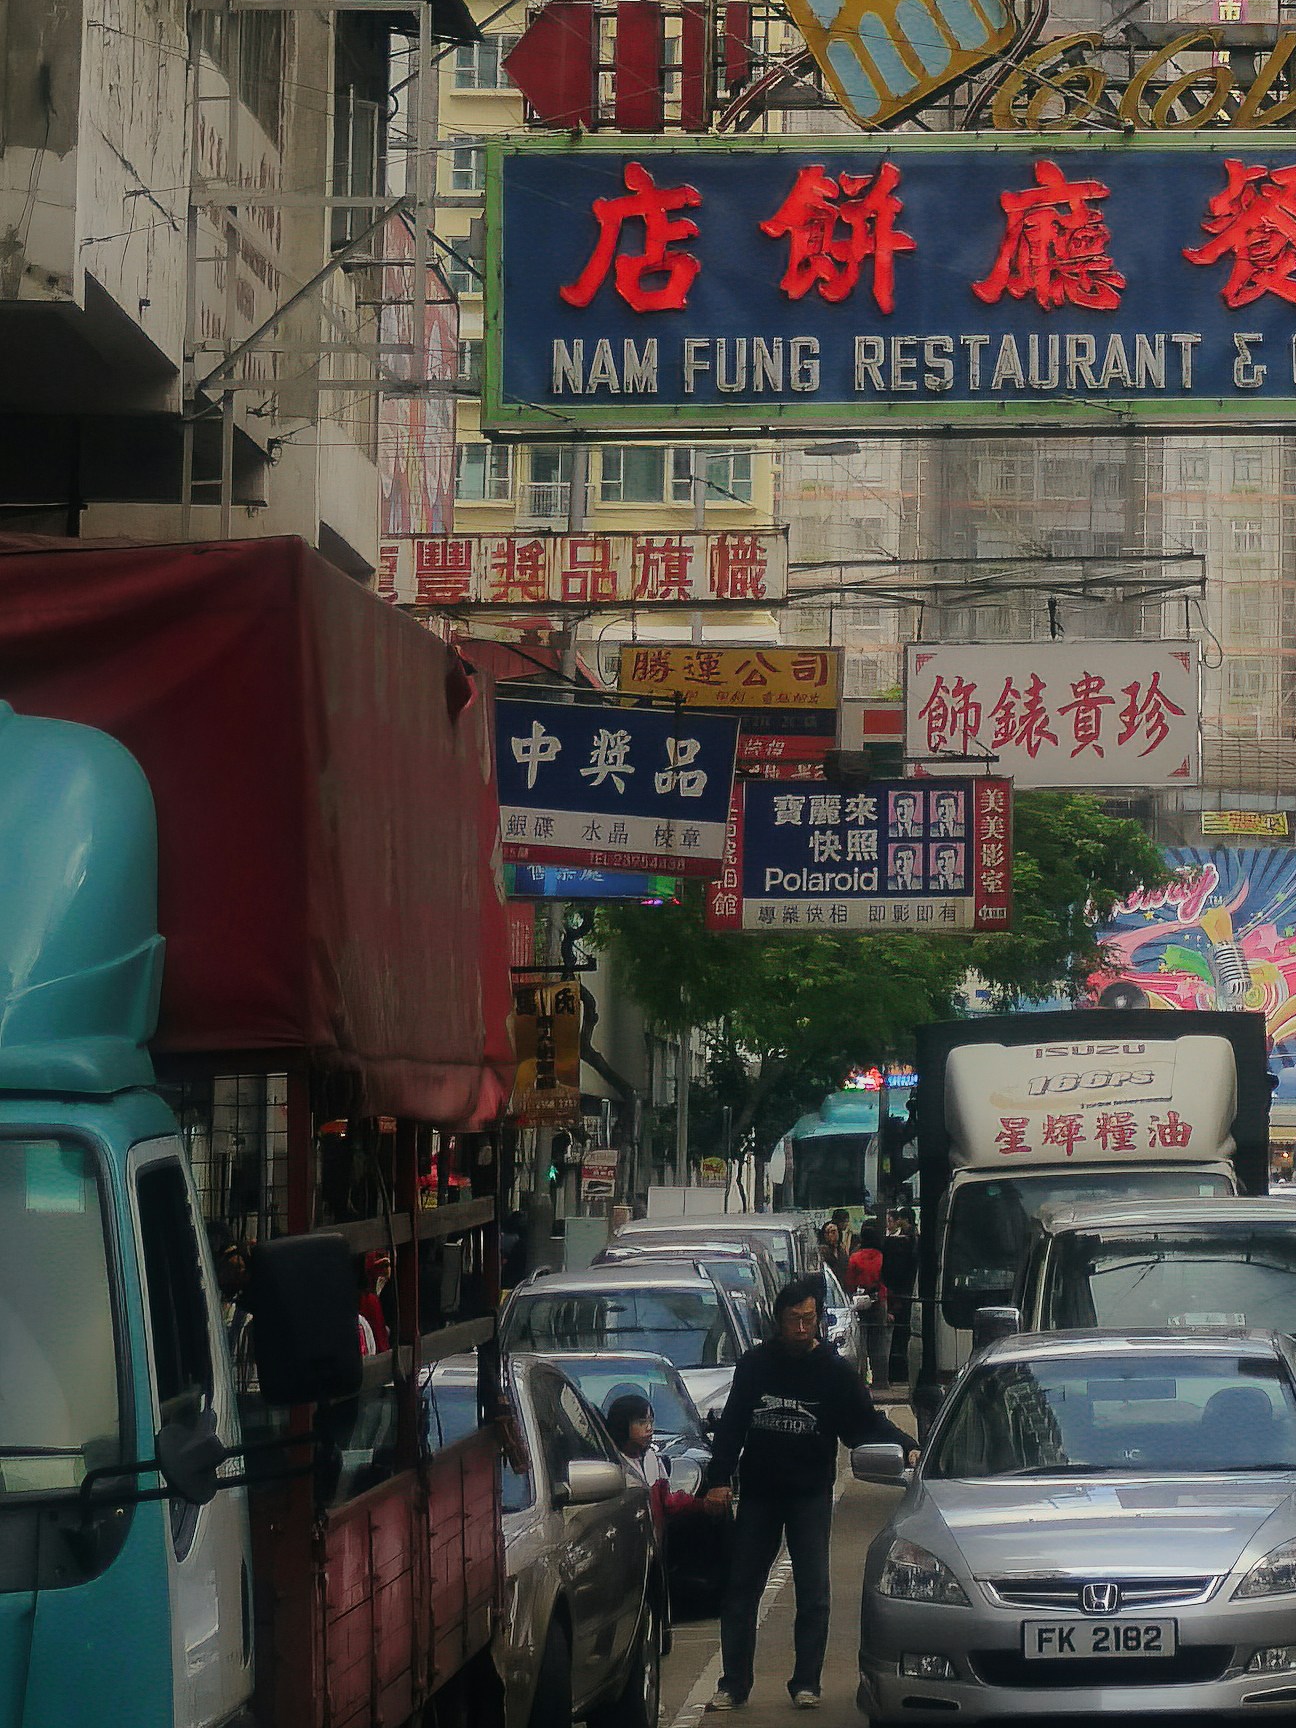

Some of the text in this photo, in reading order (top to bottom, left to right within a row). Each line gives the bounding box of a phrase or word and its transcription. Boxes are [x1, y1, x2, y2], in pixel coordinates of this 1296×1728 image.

[552, 337, 659, 396] NAM
[684, 335, 821, 394] FUNG
[854, 332, 1201, 393] RESTAURANT
[1233, 332, 1268, 389] &
[581, 819, 629, 845] 水晶
[809, 829, 878, 862] 快照
[764, 867, 879, 892] Polaroid
[1035, 1043, 1146, 1059] ISUZU
[1036, 1626, 1164, 1654] FK 2182
